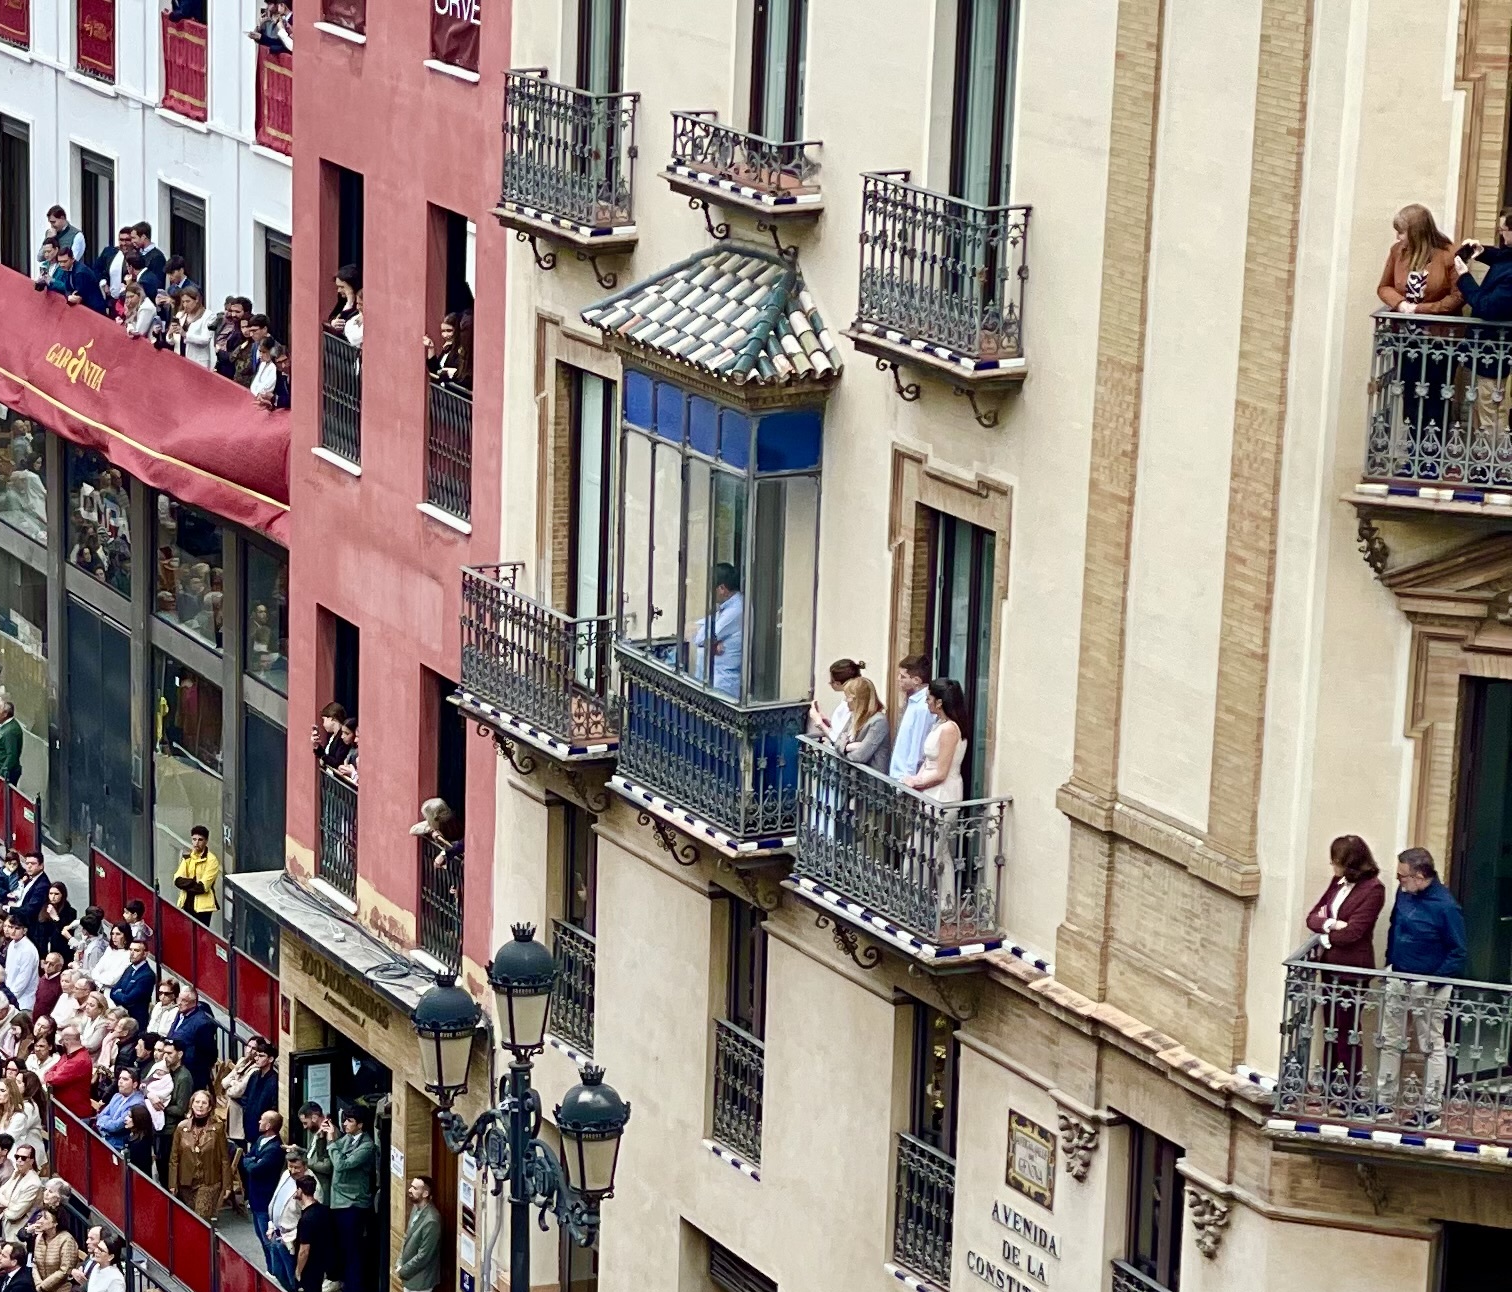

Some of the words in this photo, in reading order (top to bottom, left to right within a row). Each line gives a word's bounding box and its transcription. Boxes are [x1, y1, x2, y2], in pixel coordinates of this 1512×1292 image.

[991, 1200, 1058, 1257] AVENIDA
[1002, 1239, 1021, 1267] DE
[1027, 1254, 1047, 1282] LA
